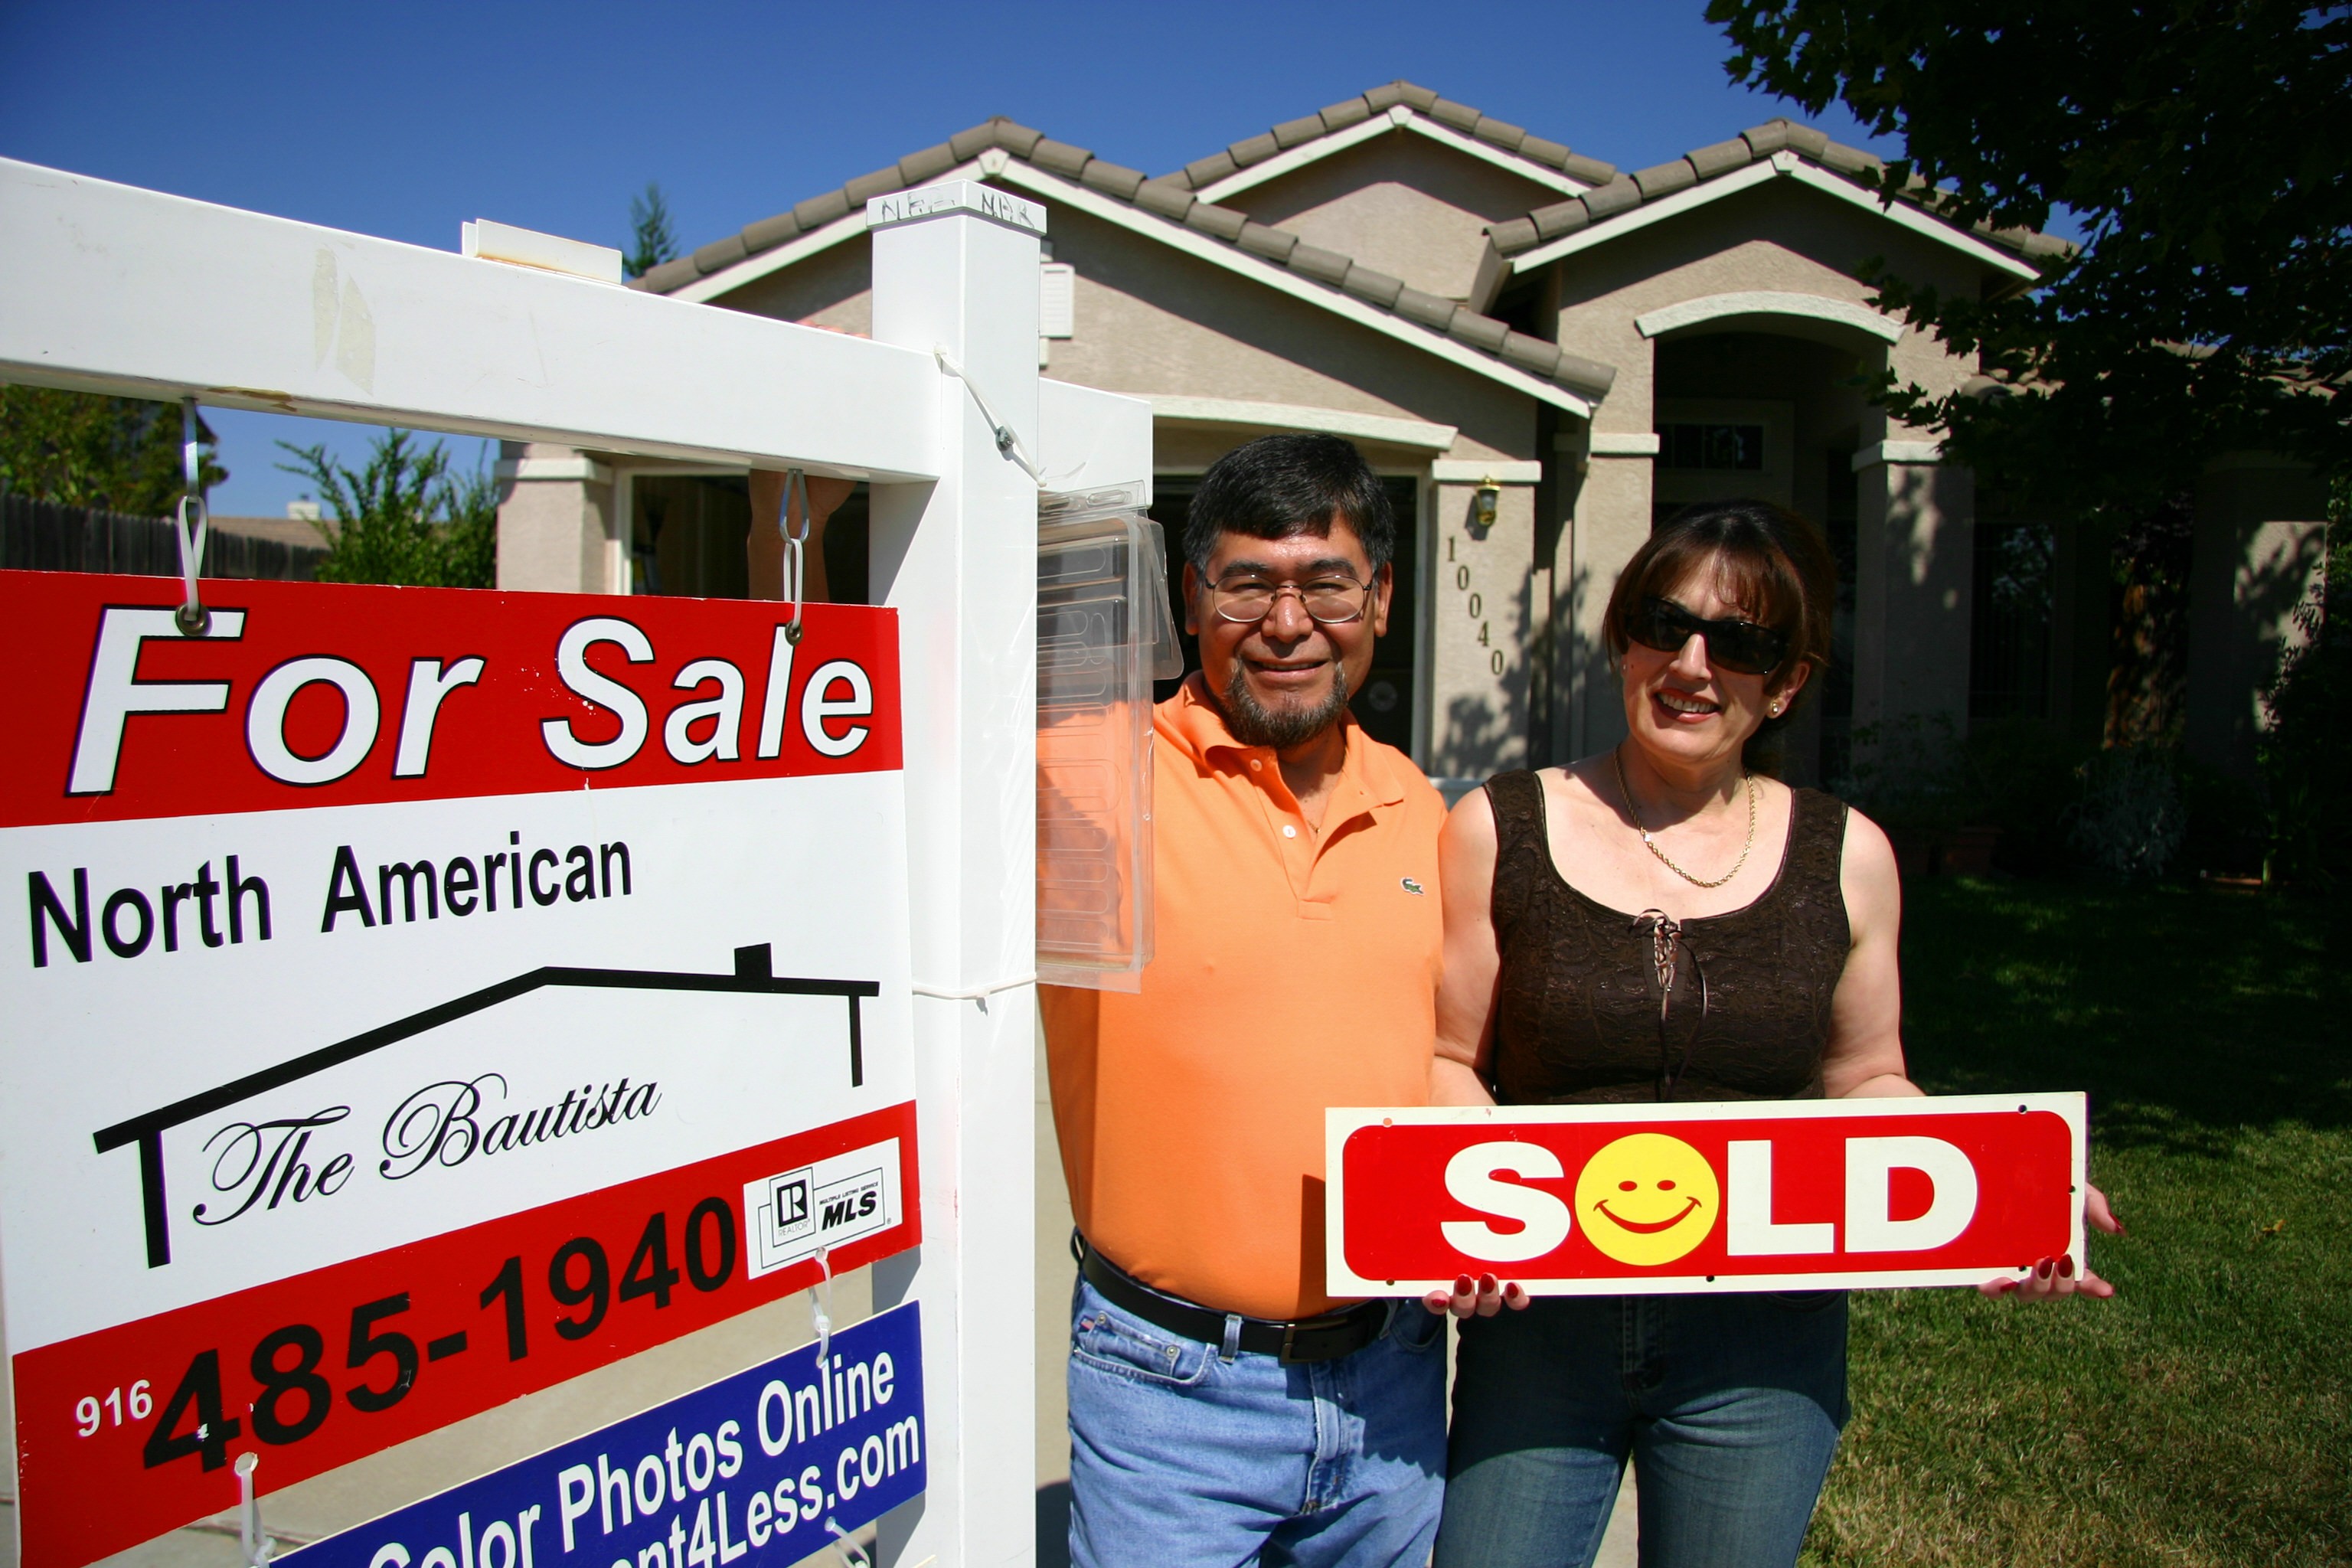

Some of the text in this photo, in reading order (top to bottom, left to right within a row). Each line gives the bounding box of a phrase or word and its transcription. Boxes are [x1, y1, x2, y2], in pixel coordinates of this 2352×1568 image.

[1447, 535, 1504, 675] 10040
[64, 603, 873, 797] For Sale
[28, 830, 632, 967] North American
[193, 1073, 663, 1226] The Bautista
[822, 1191, 877, 1231] MLS
[76, 1196, 737, 1474] 916 485-1940
[369, 1352, 894, 1568] lor Photos Online
